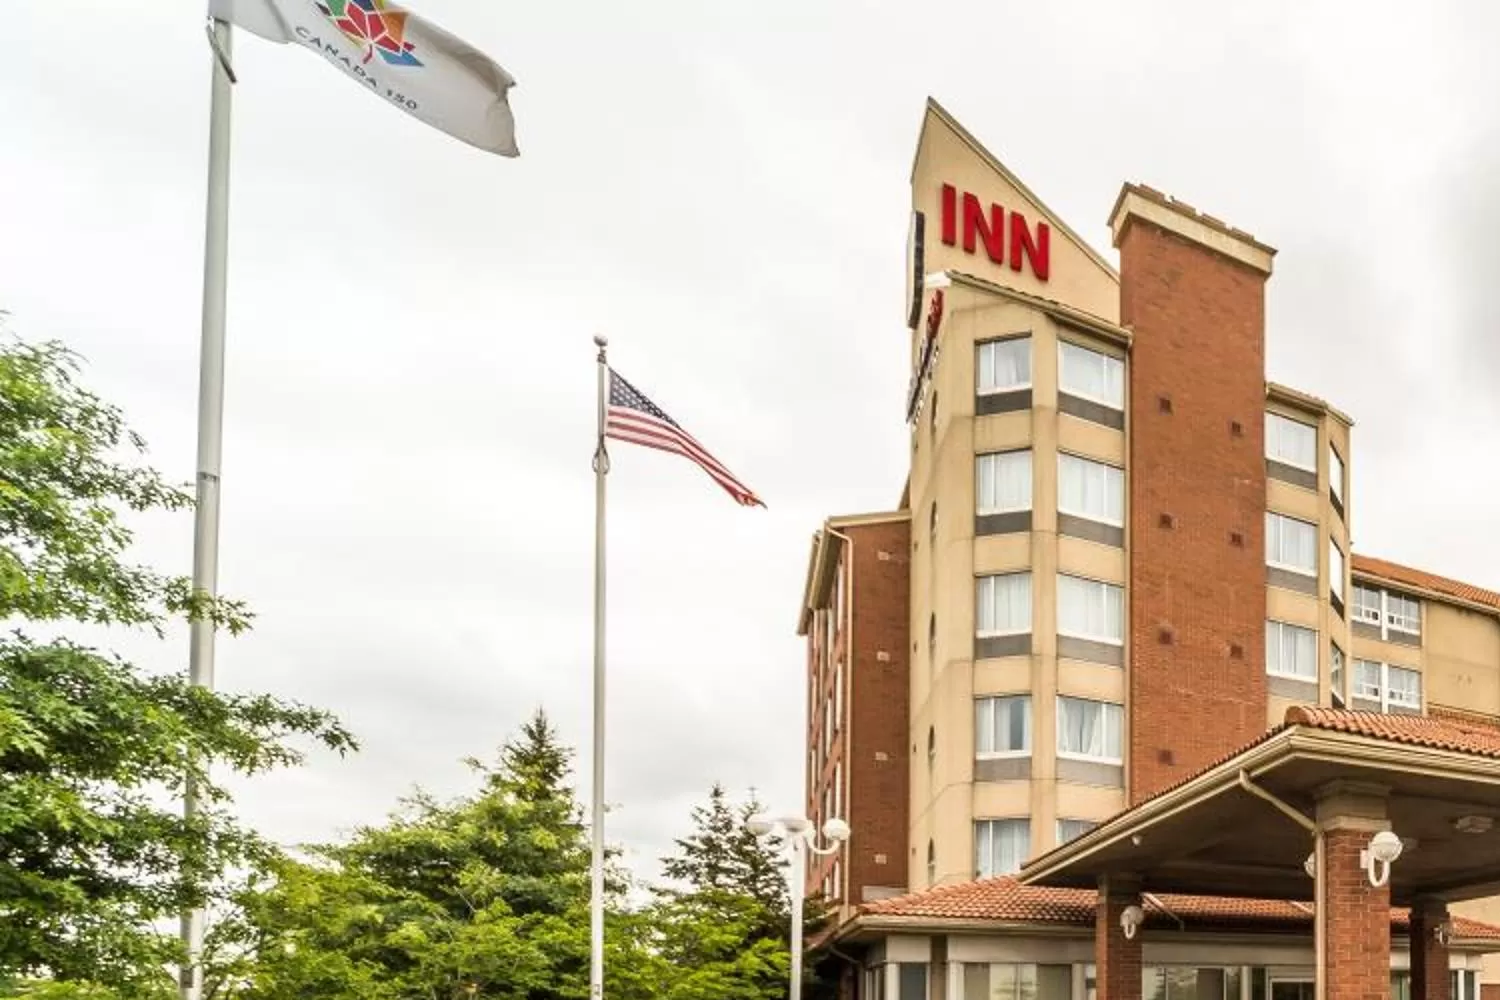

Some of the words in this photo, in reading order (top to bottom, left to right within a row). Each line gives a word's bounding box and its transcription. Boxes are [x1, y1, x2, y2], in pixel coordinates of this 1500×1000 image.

[295, 26, 377, 88] CANADA
[387, 89, 417, 110] 150
[941, 183, 1049, 282] INN
